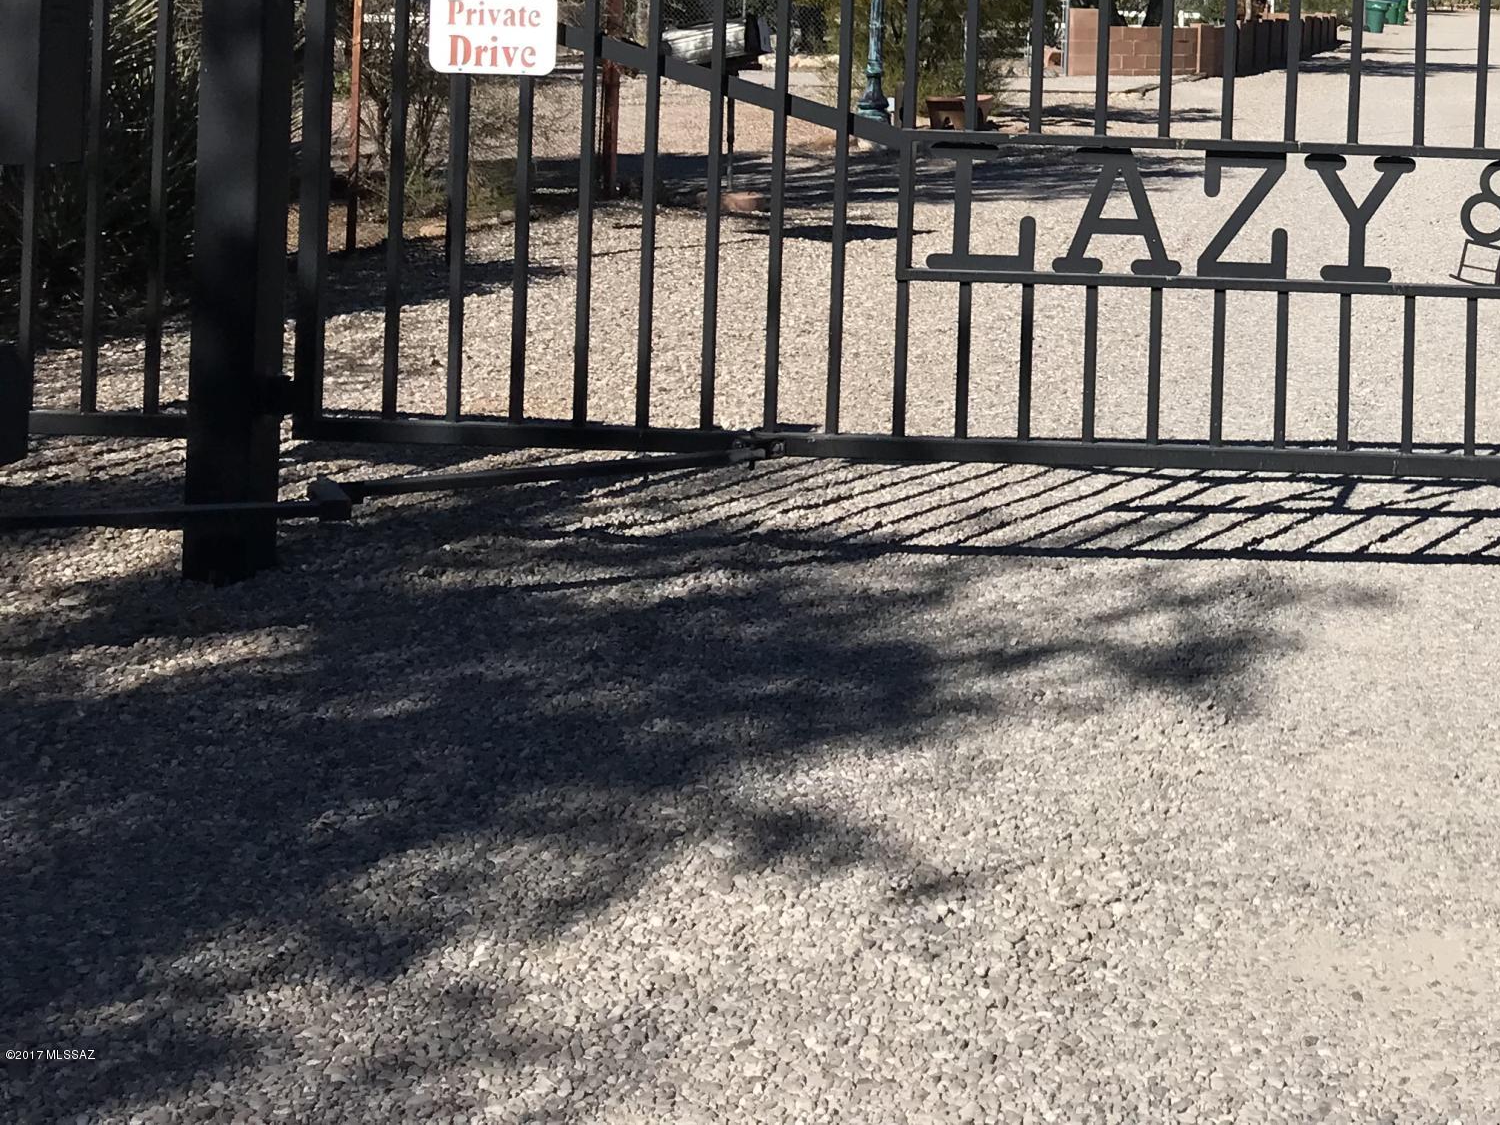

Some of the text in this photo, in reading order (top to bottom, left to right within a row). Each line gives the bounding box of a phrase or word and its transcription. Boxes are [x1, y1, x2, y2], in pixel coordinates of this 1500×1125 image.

[448, 0, 541, 27] Private
[448, 34, 536, 68] Drive
[925, 141, 1417, 283] LAZY
